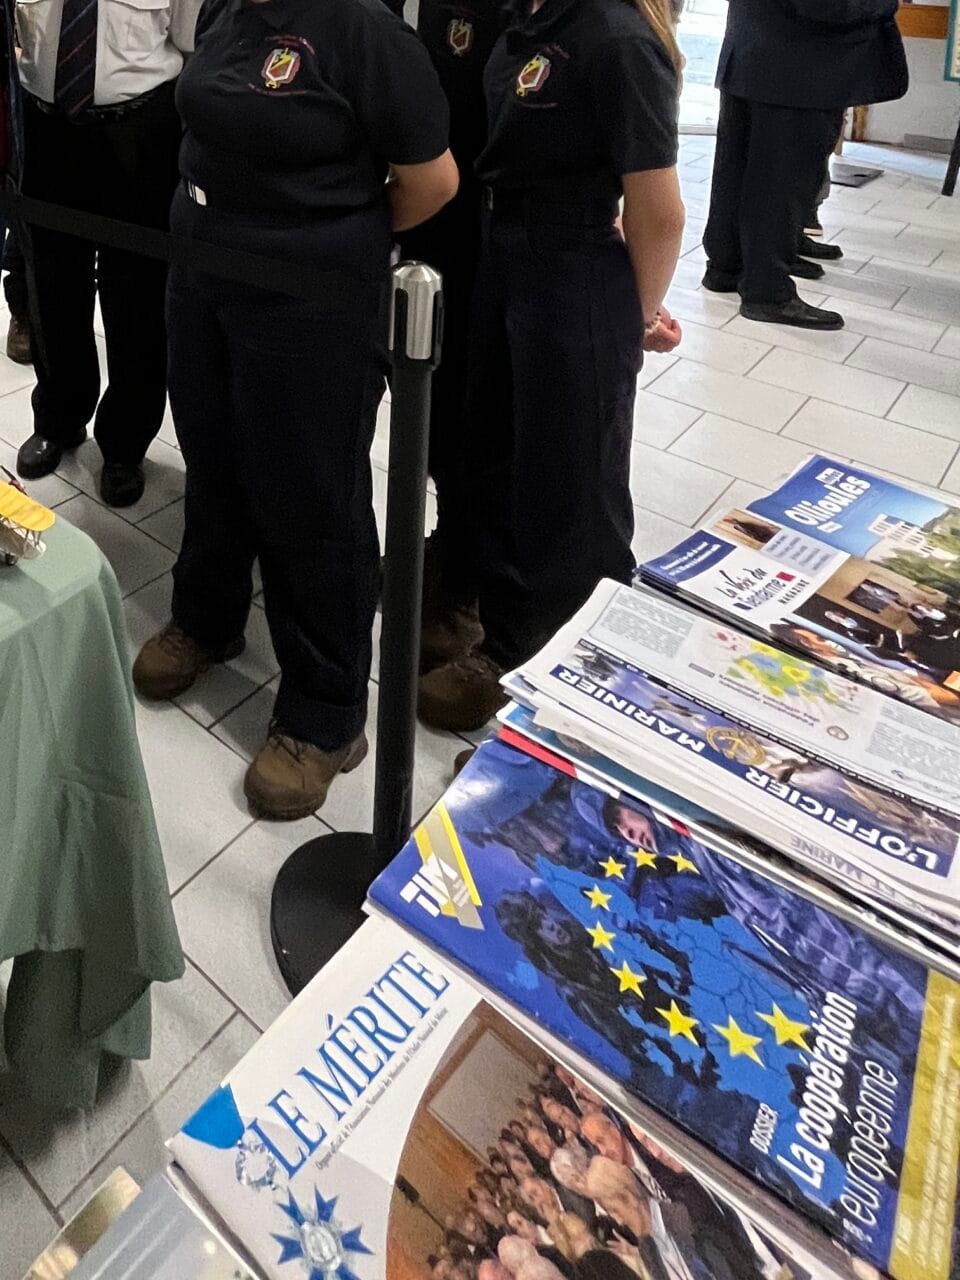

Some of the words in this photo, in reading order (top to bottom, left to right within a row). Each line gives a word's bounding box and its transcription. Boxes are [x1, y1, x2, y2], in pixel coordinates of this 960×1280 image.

[784, 475, 871, 526] Ollioules
[778, 579, 811, 605] MAGAZINE
[558, 668, 706, 752] MARINIER
[745, 767, 939, 870] L'OFFICIER
[247, 1089, 328, 1180] LE
[296, 950, 451, 1121] MÉRITE
[796, 991, 857, 1151] coopération
[750, 1103, 779, 1155] DOSSIER
[777, 1143, 825, 1190] La
[840, 1060, 899, 1227] européenne
